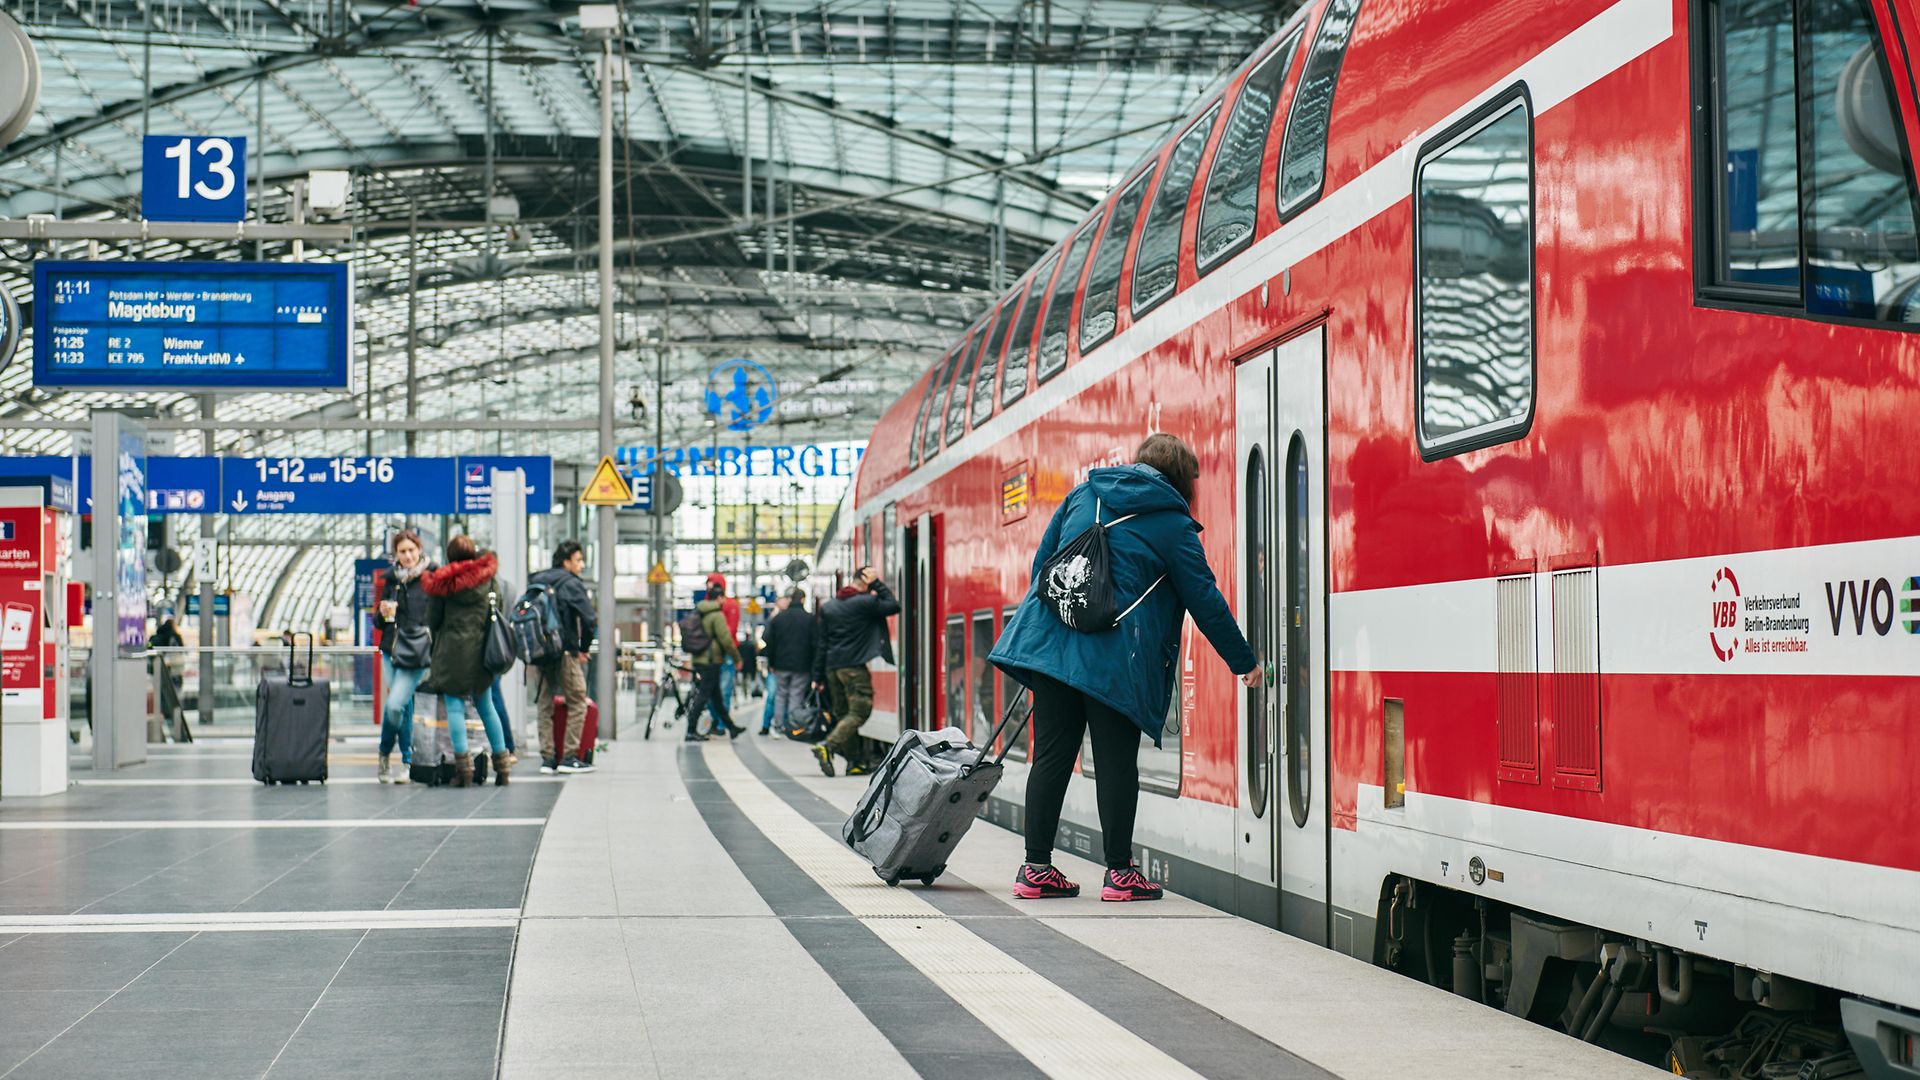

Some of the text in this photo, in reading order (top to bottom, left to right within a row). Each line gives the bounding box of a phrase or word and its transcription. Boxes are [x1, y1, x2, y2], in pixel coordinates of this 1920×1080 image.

[165, 138, 235, 200] 13
[56, 281, 90, 294] 11:11
[109, 301, 195, 322] Magdeburg
[54, 337, 203, 349] 11:25 RE 2 Wismar
[108, 353, 123, 363] ICE
[163, 352, 230, 364] Frankfurt(M)
[256, 458, 394, 482] 1-12 und 15-16
[256, 490, 295, 503] Ausgang
[632, 477, 649, 503] E
[1713, 592, 1800, 628] VBB Verkehrsverbund
[1825, 577, 1894, 636] VVO
[1744, 615, 1809, 634] Berlin-Brandenburg
[1744, 637, 1809, 653] Alles ist erreichbar.
